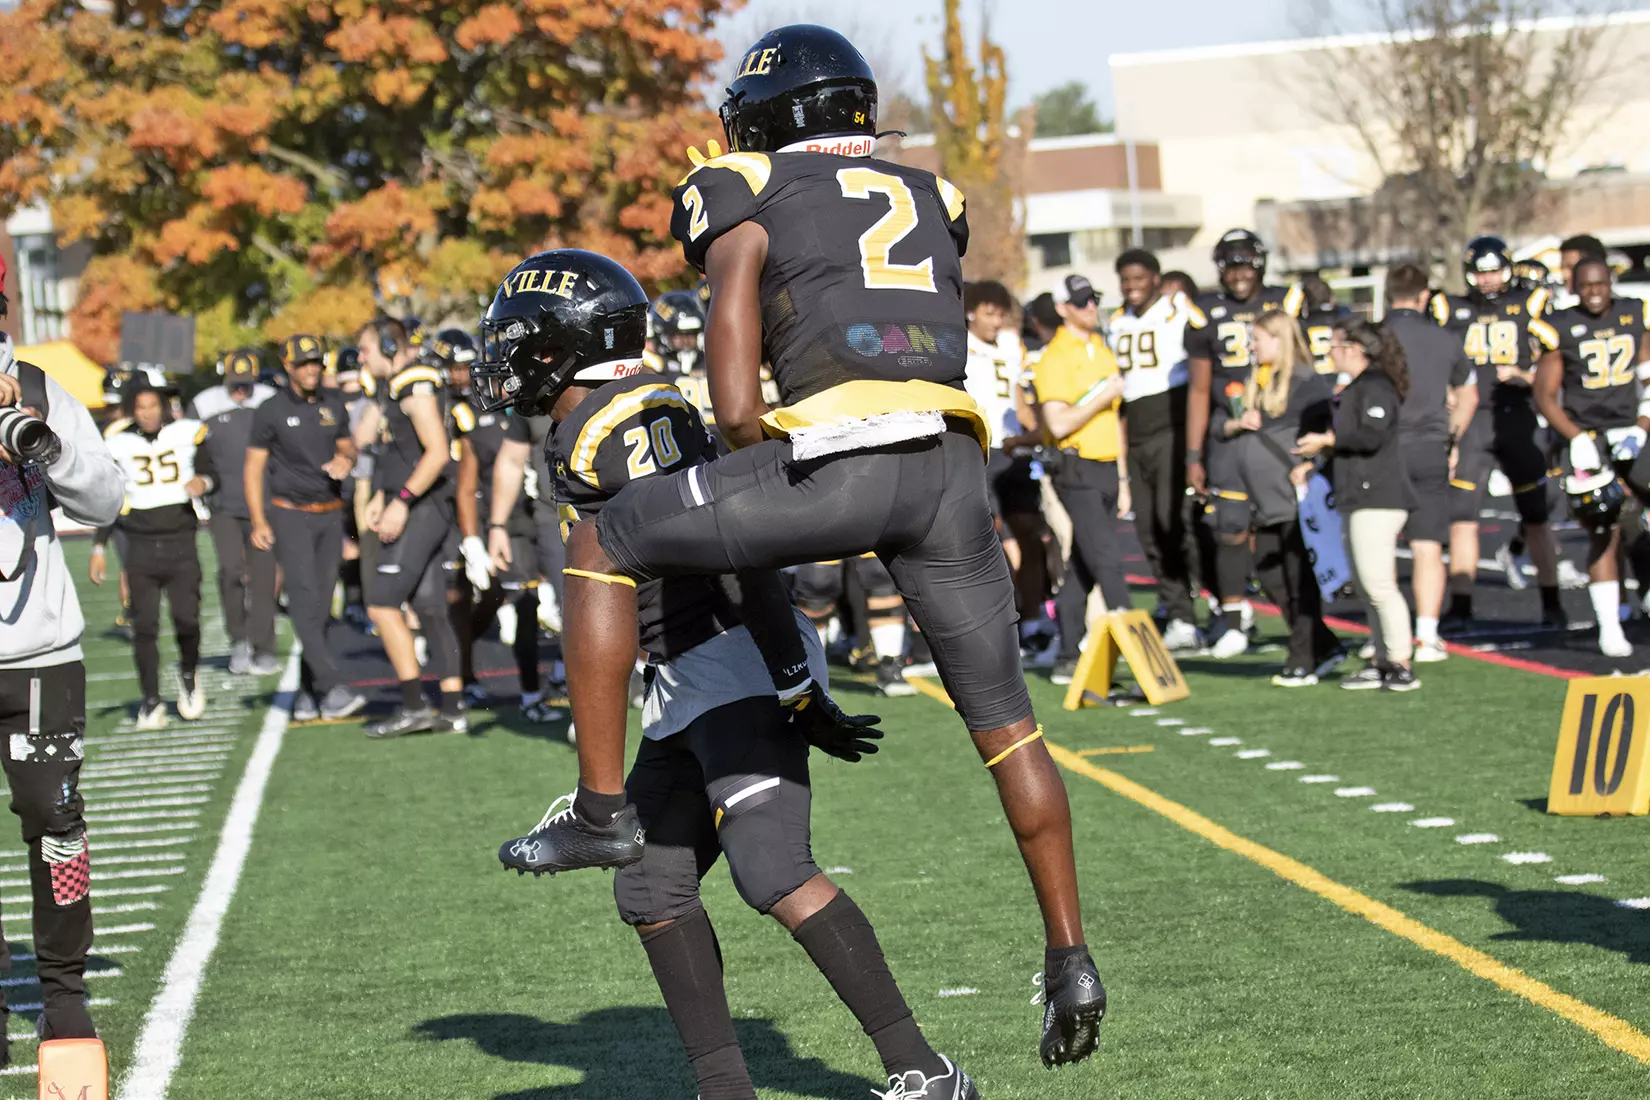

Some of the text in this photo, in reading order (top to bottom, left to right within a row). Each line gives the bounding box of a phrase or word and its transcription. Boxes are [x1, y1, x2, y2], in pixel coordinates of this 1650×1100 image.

[854, 111, 865, 125] 54
[682, 184, 710, 242] 2
[836, 167, 938, 293] 2
[503, 269, 579, 299] VILLE
[1116, 331, 1158, 371] 99
[1464, 321, 1518, 366] 48
[1579, 334, 1635, 389] 32
[132, 450, 179, 486] 35
[623, 416, 682, 480] 20
[1128, 621, 1177, 687] 20
[1569, 693, 1634, 797] 10
